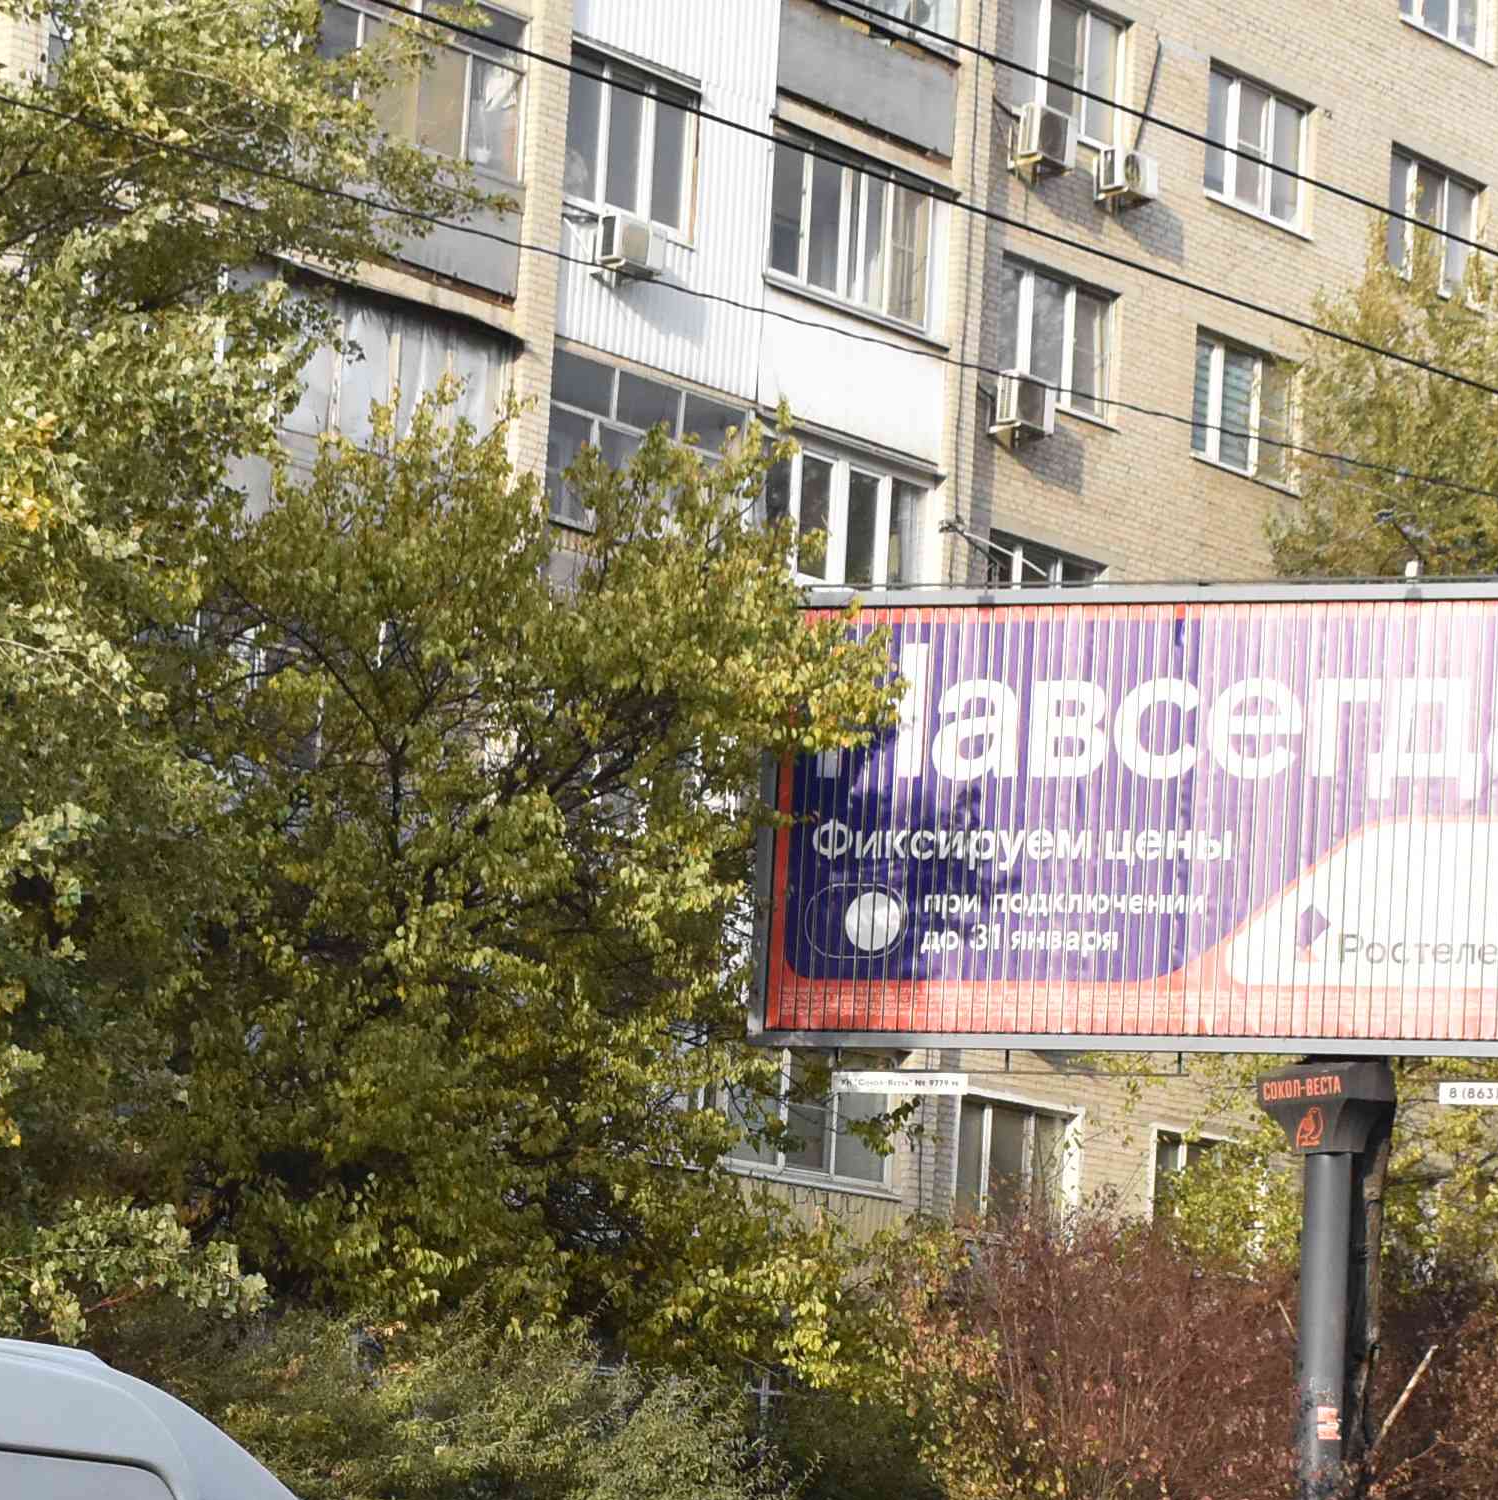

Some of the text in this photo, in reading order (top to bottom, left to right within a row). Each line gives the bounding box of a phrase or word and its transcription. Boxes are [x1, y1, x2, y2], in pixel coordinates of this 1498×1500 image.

[812, 818, 1233, 871] Фиксируем цены
[923, 892, 1205, 918] при подключении
[919, 924, 1119, 957] до 31 января
[1262, 1075, 1342, 1101] СОКОЛ-ВЕСТА
[1448, 1087, 1458, 1099] 8
